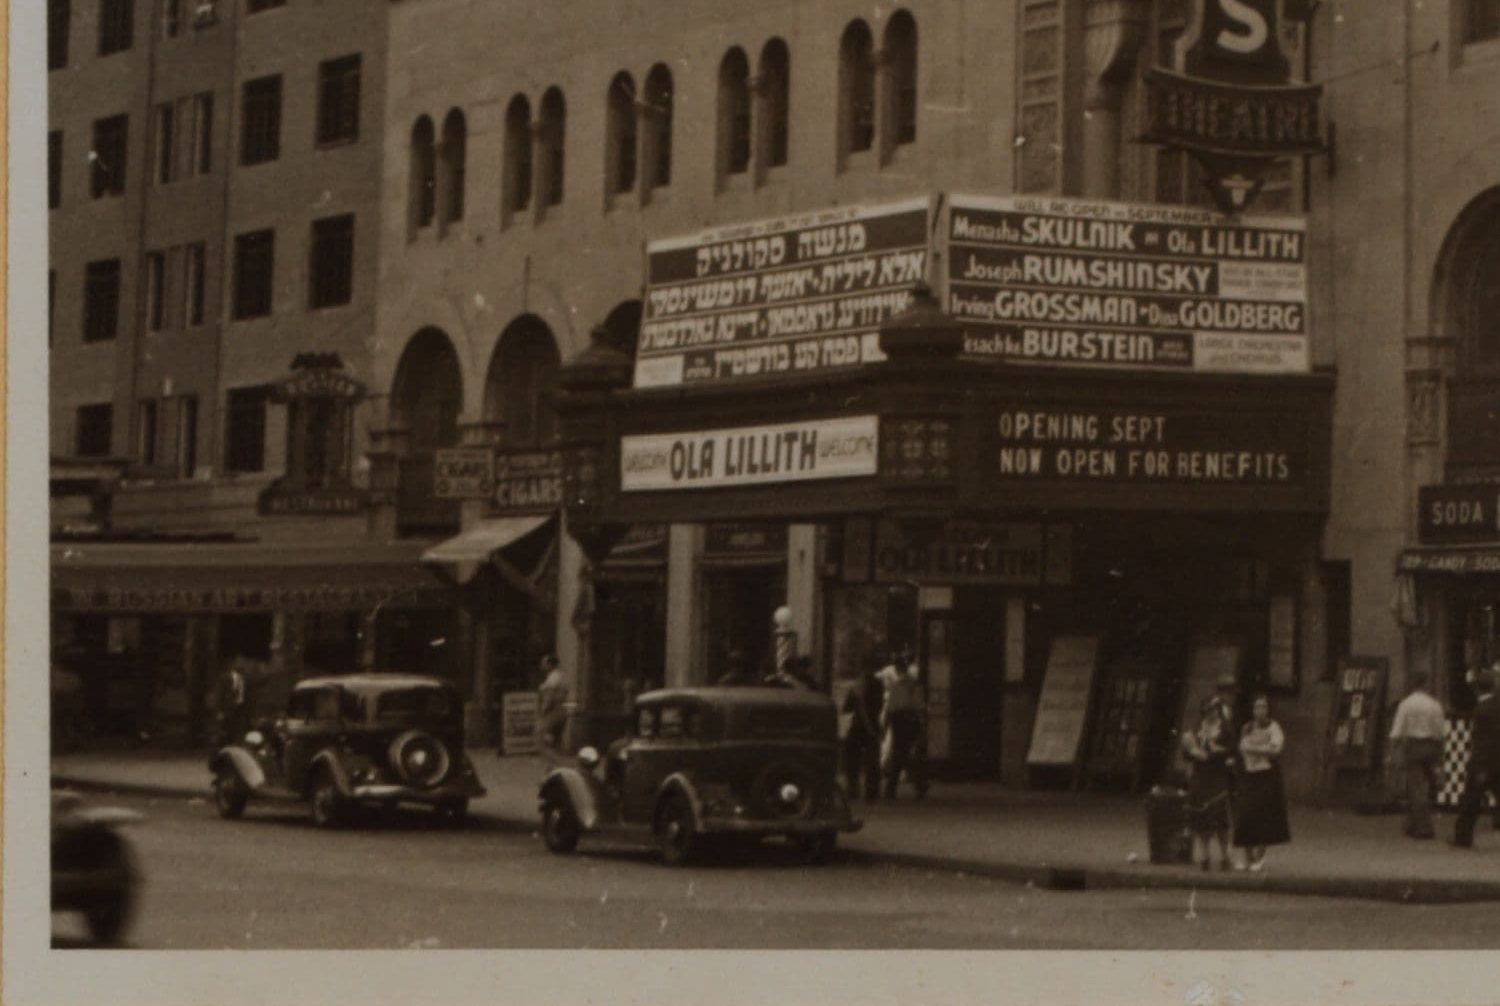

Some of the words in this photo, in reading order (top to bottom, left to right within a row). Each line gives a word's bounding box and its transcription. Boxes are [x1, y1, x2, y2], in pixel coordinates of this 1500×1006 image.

[798, 224, 866, 258] מנשה
[953, 216, 1018, 243] Menasha
[1021, 215, 1135, 251] SKULNIK
[1166, 229, 1195, 255] Ola
[1201, 228, 1300, 259] LILLITH
[696, 236, 785, 276] סקולניק
[963, 253, 1021, 284] Joseph
[1023, 255, 1212, 293] RUMSHINSKY
[951, 291, 994, 321] Irving
[995, 290, 1137, 323] GROSSMAN
[1179, 300, 1301, 332] GOLDBERG
[1023, 328, 1154, 362] BURSTEIN
[999, 410, 1099, 442] OPENING
[1110, 414, 1167, 443] SEPT
[671, 439, 715, 481] OLA
[725, 429, 818, 477] LILLITH
[999, 447, 1043, 475] NOW
[1055, 448, 1117, 477] OPEN
[1128, 450, 1170, 479] FOR
[1176, 451, 1289, 480] BENEFITS
[1431, 501, 1484, 526] SODA
